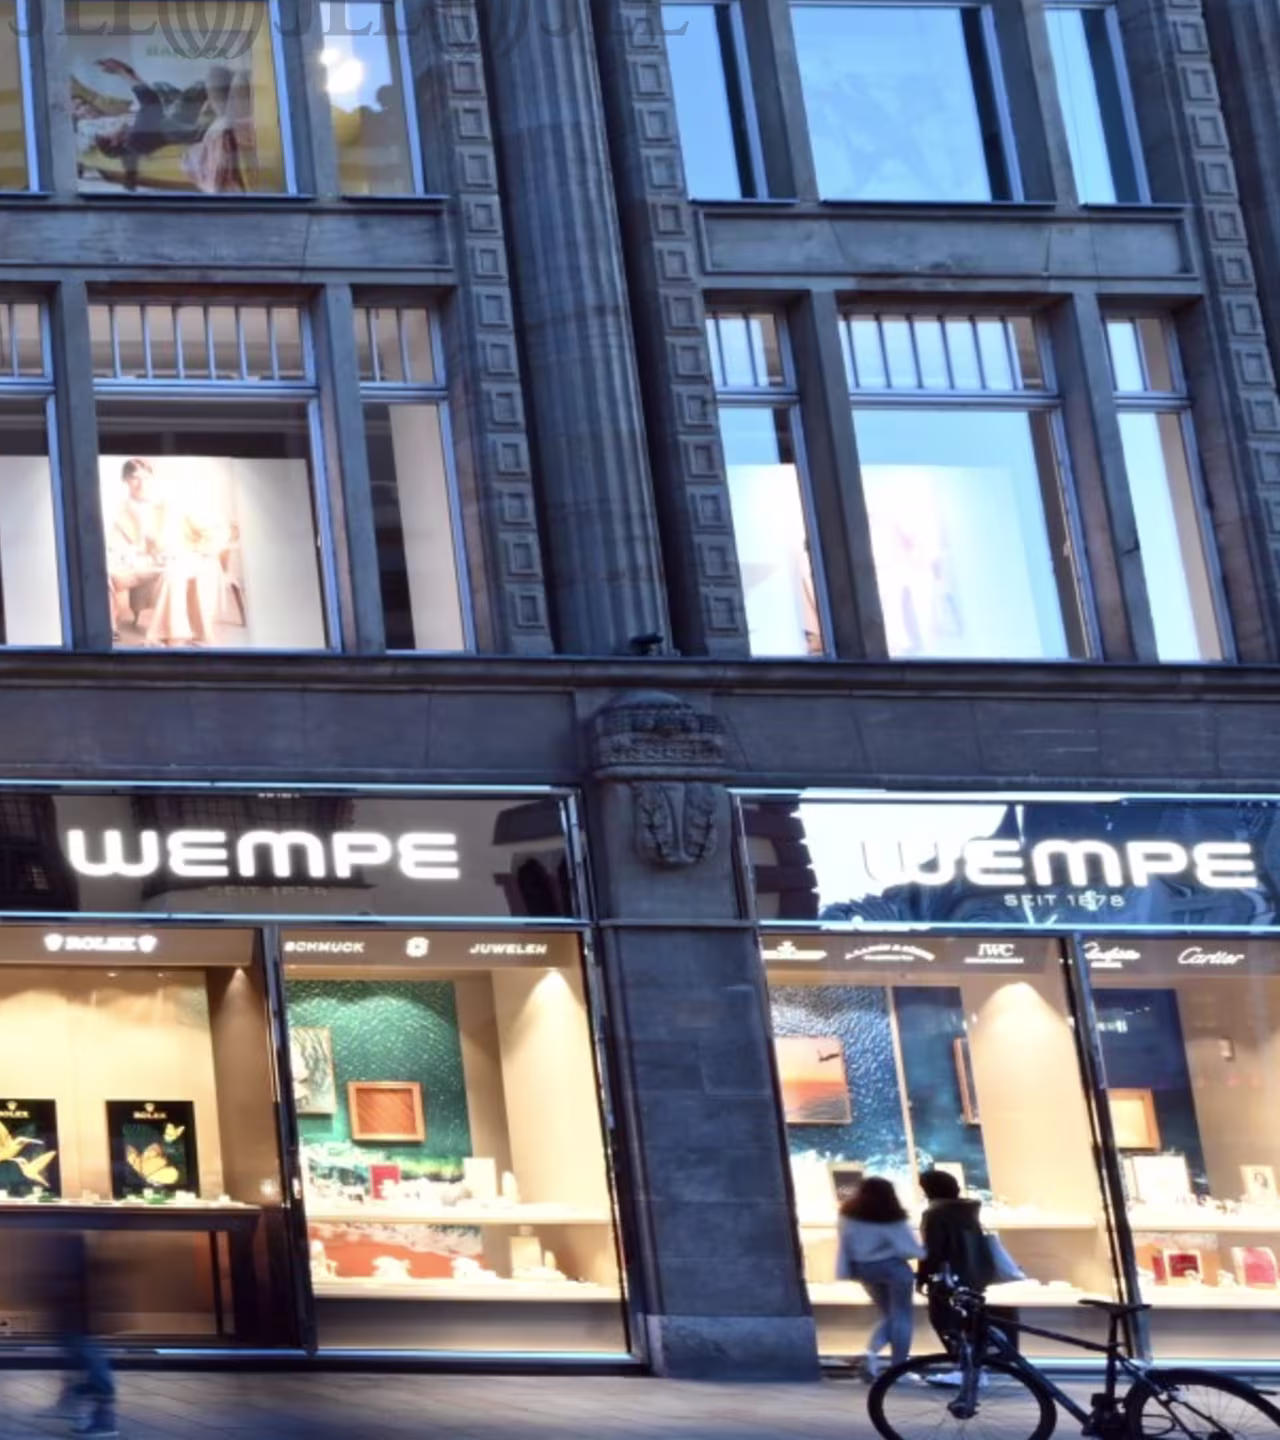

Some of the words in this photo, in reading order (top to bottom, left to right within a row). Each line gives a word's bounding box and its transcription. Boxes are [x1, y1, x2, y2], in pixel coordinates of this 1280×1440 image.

[66, 829, 461, 880] WEMPE
[861, 838, 1258, 888] WEMPE
[1003, 894, 1056, 907] SEIT
[284, 941, 366, 954] SCHMUCK
[470, 942, 548, 955] JUWELEN
[977, 943, 1016, 957] IWC
[1177, 946, 1245, 966] Cartier
